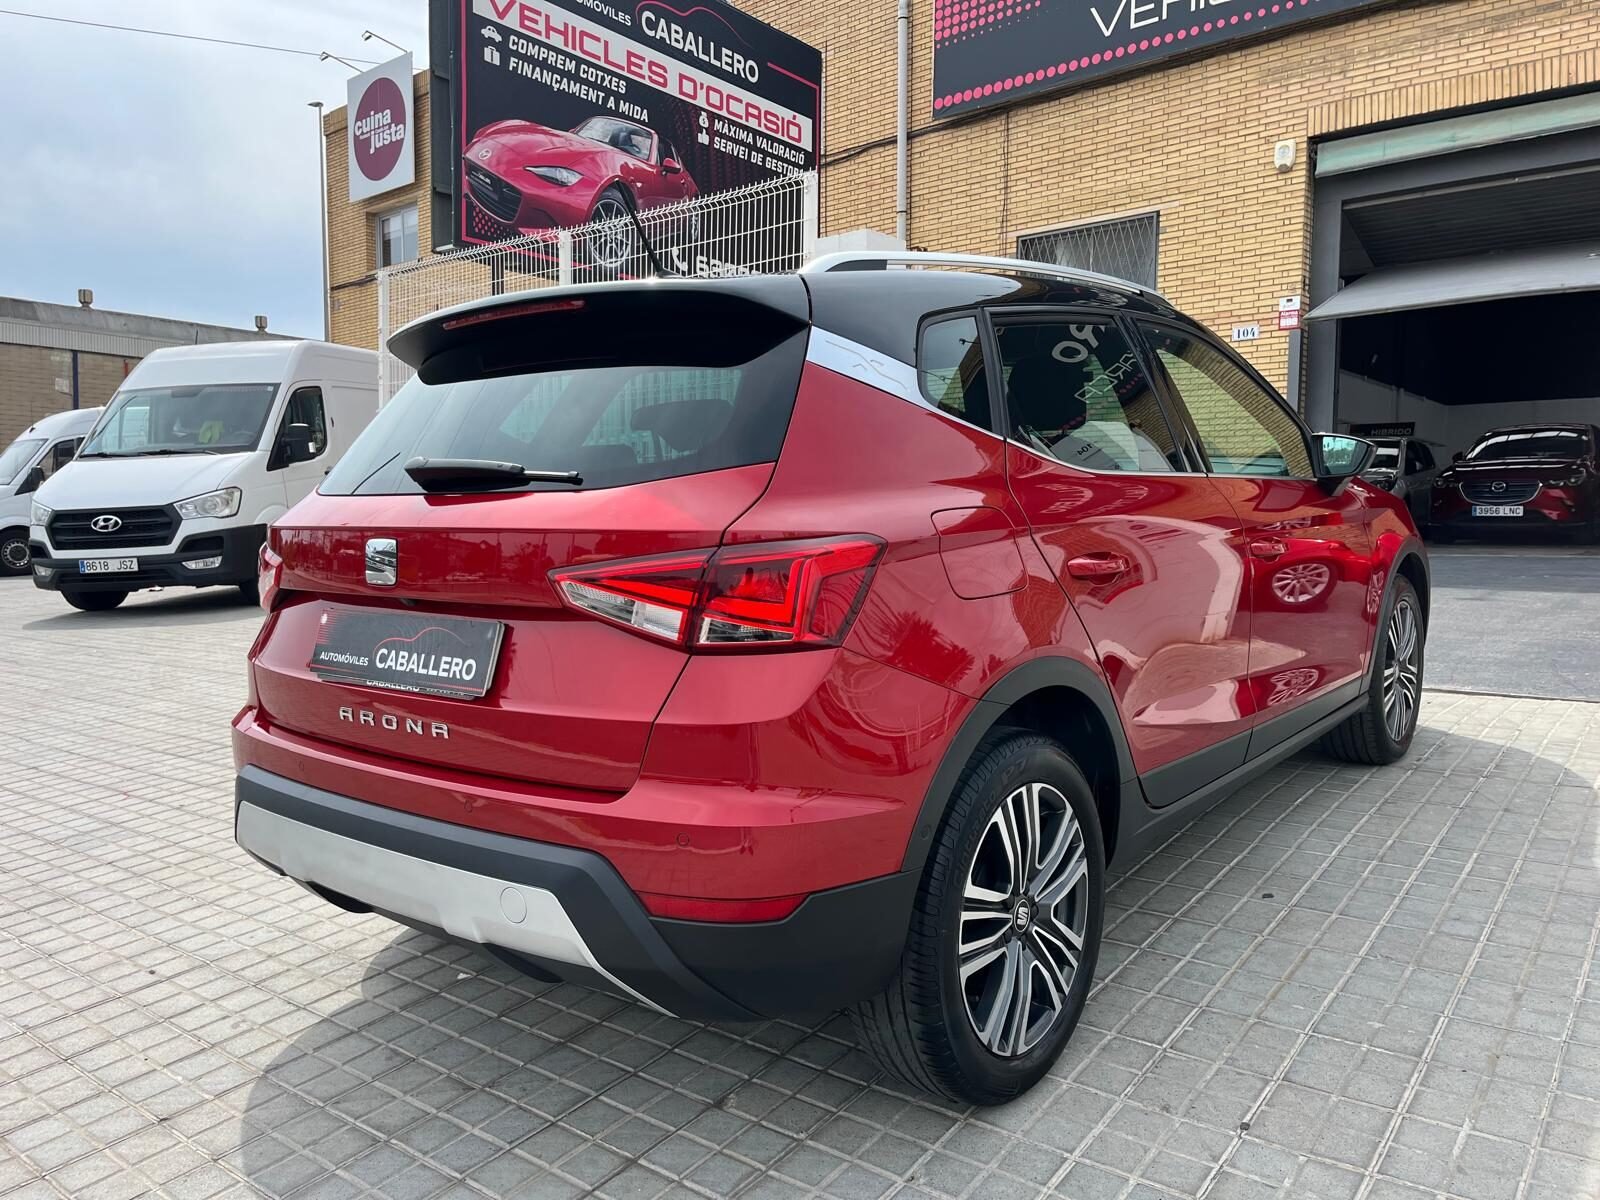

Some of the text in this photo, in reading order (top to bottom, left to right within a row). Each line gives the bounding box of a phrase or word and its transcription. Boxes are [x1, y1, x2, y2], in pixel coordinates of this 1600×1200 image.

[576, 0, 759, 83] MOVILES CABALLERO
[489, 0, 802, 144] VEHICLES D'OCASIÓ
[508, 35, 627, 94] COMPREM COTXES
[508, 56, 649, 122] FINANÇAMENT A MIDA
[354, 108, 391, 136] cuina
[370, 123, 405, 155] justa
[713, 137, 749, 161] SERVEI
[751, 151, 764, 166] DE
[714, 118, 805, 165] MÀXIMA VALORACIÓ
[1237, 327, 1256, 339] 104
[1478, 506, 1521, 515] 3956 LNC
[85, 559, 135, 571] 8618 JSZ
[319, 648, 477, 681] AUTOMÓVILES CABALLERO
[339, 706, 449, 739] ARONA
